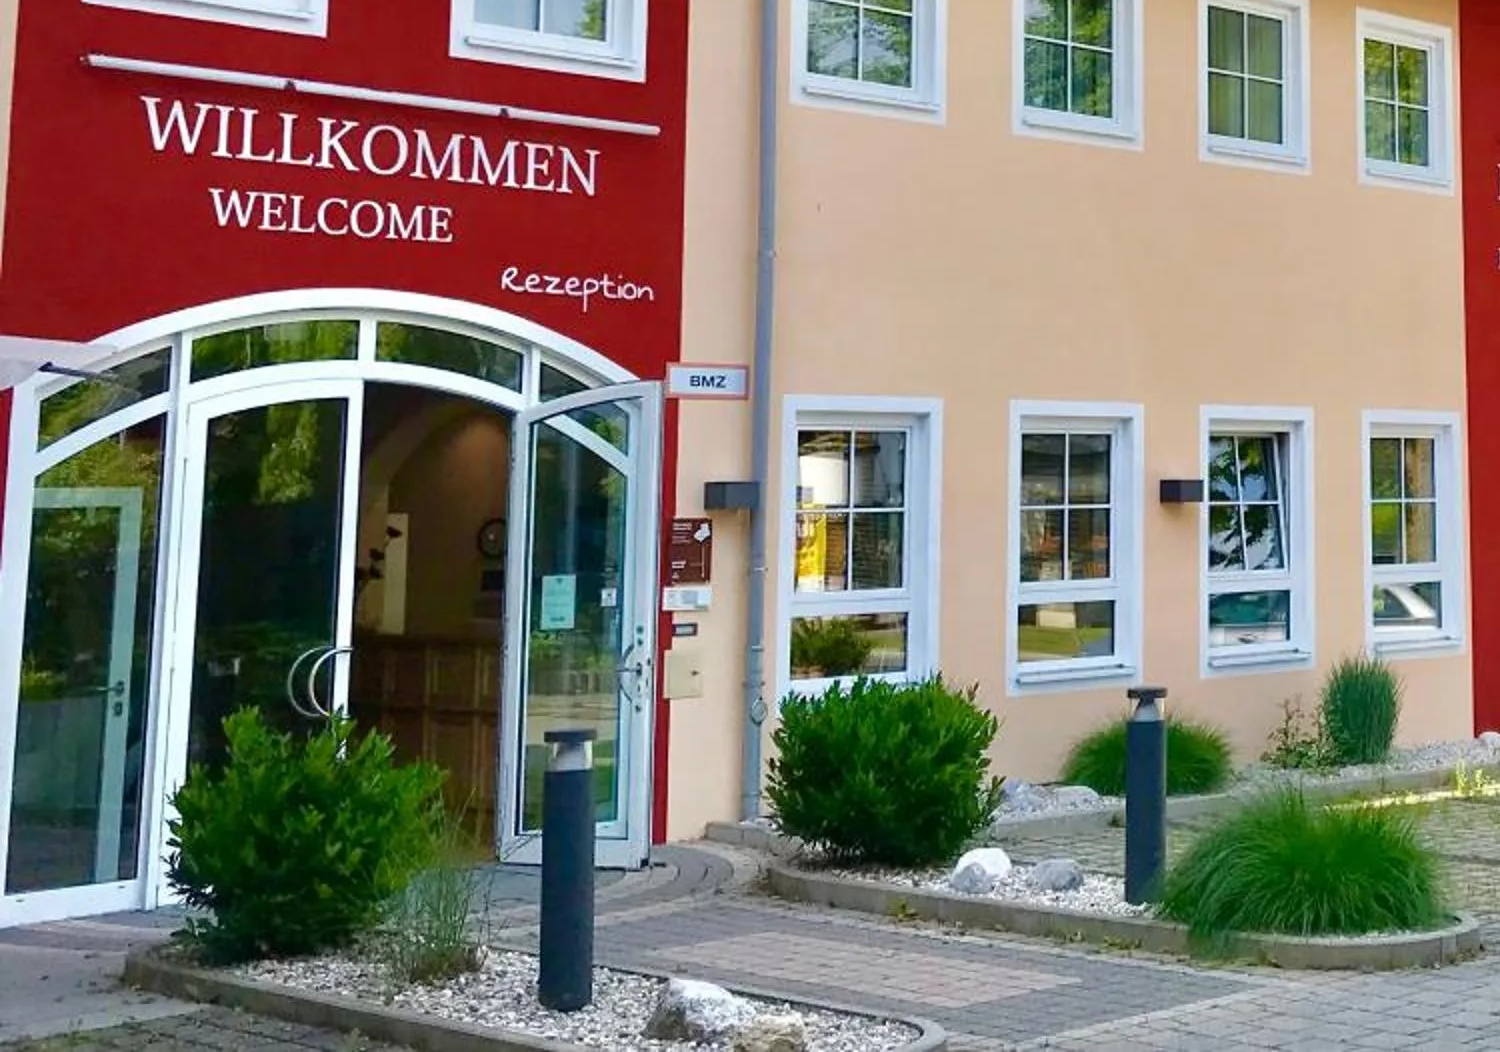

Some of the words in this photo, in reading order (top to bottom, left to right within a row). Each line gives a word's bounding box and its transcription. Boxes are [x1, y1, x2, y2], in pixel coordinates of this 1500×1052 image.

[140, 96, 600, 196] WILLKOMMEN
[208, 188, 453, 242] WELCOME
[501, 266, 654, 312] Rezeption
[689, 375, 726, 388] BMZ
